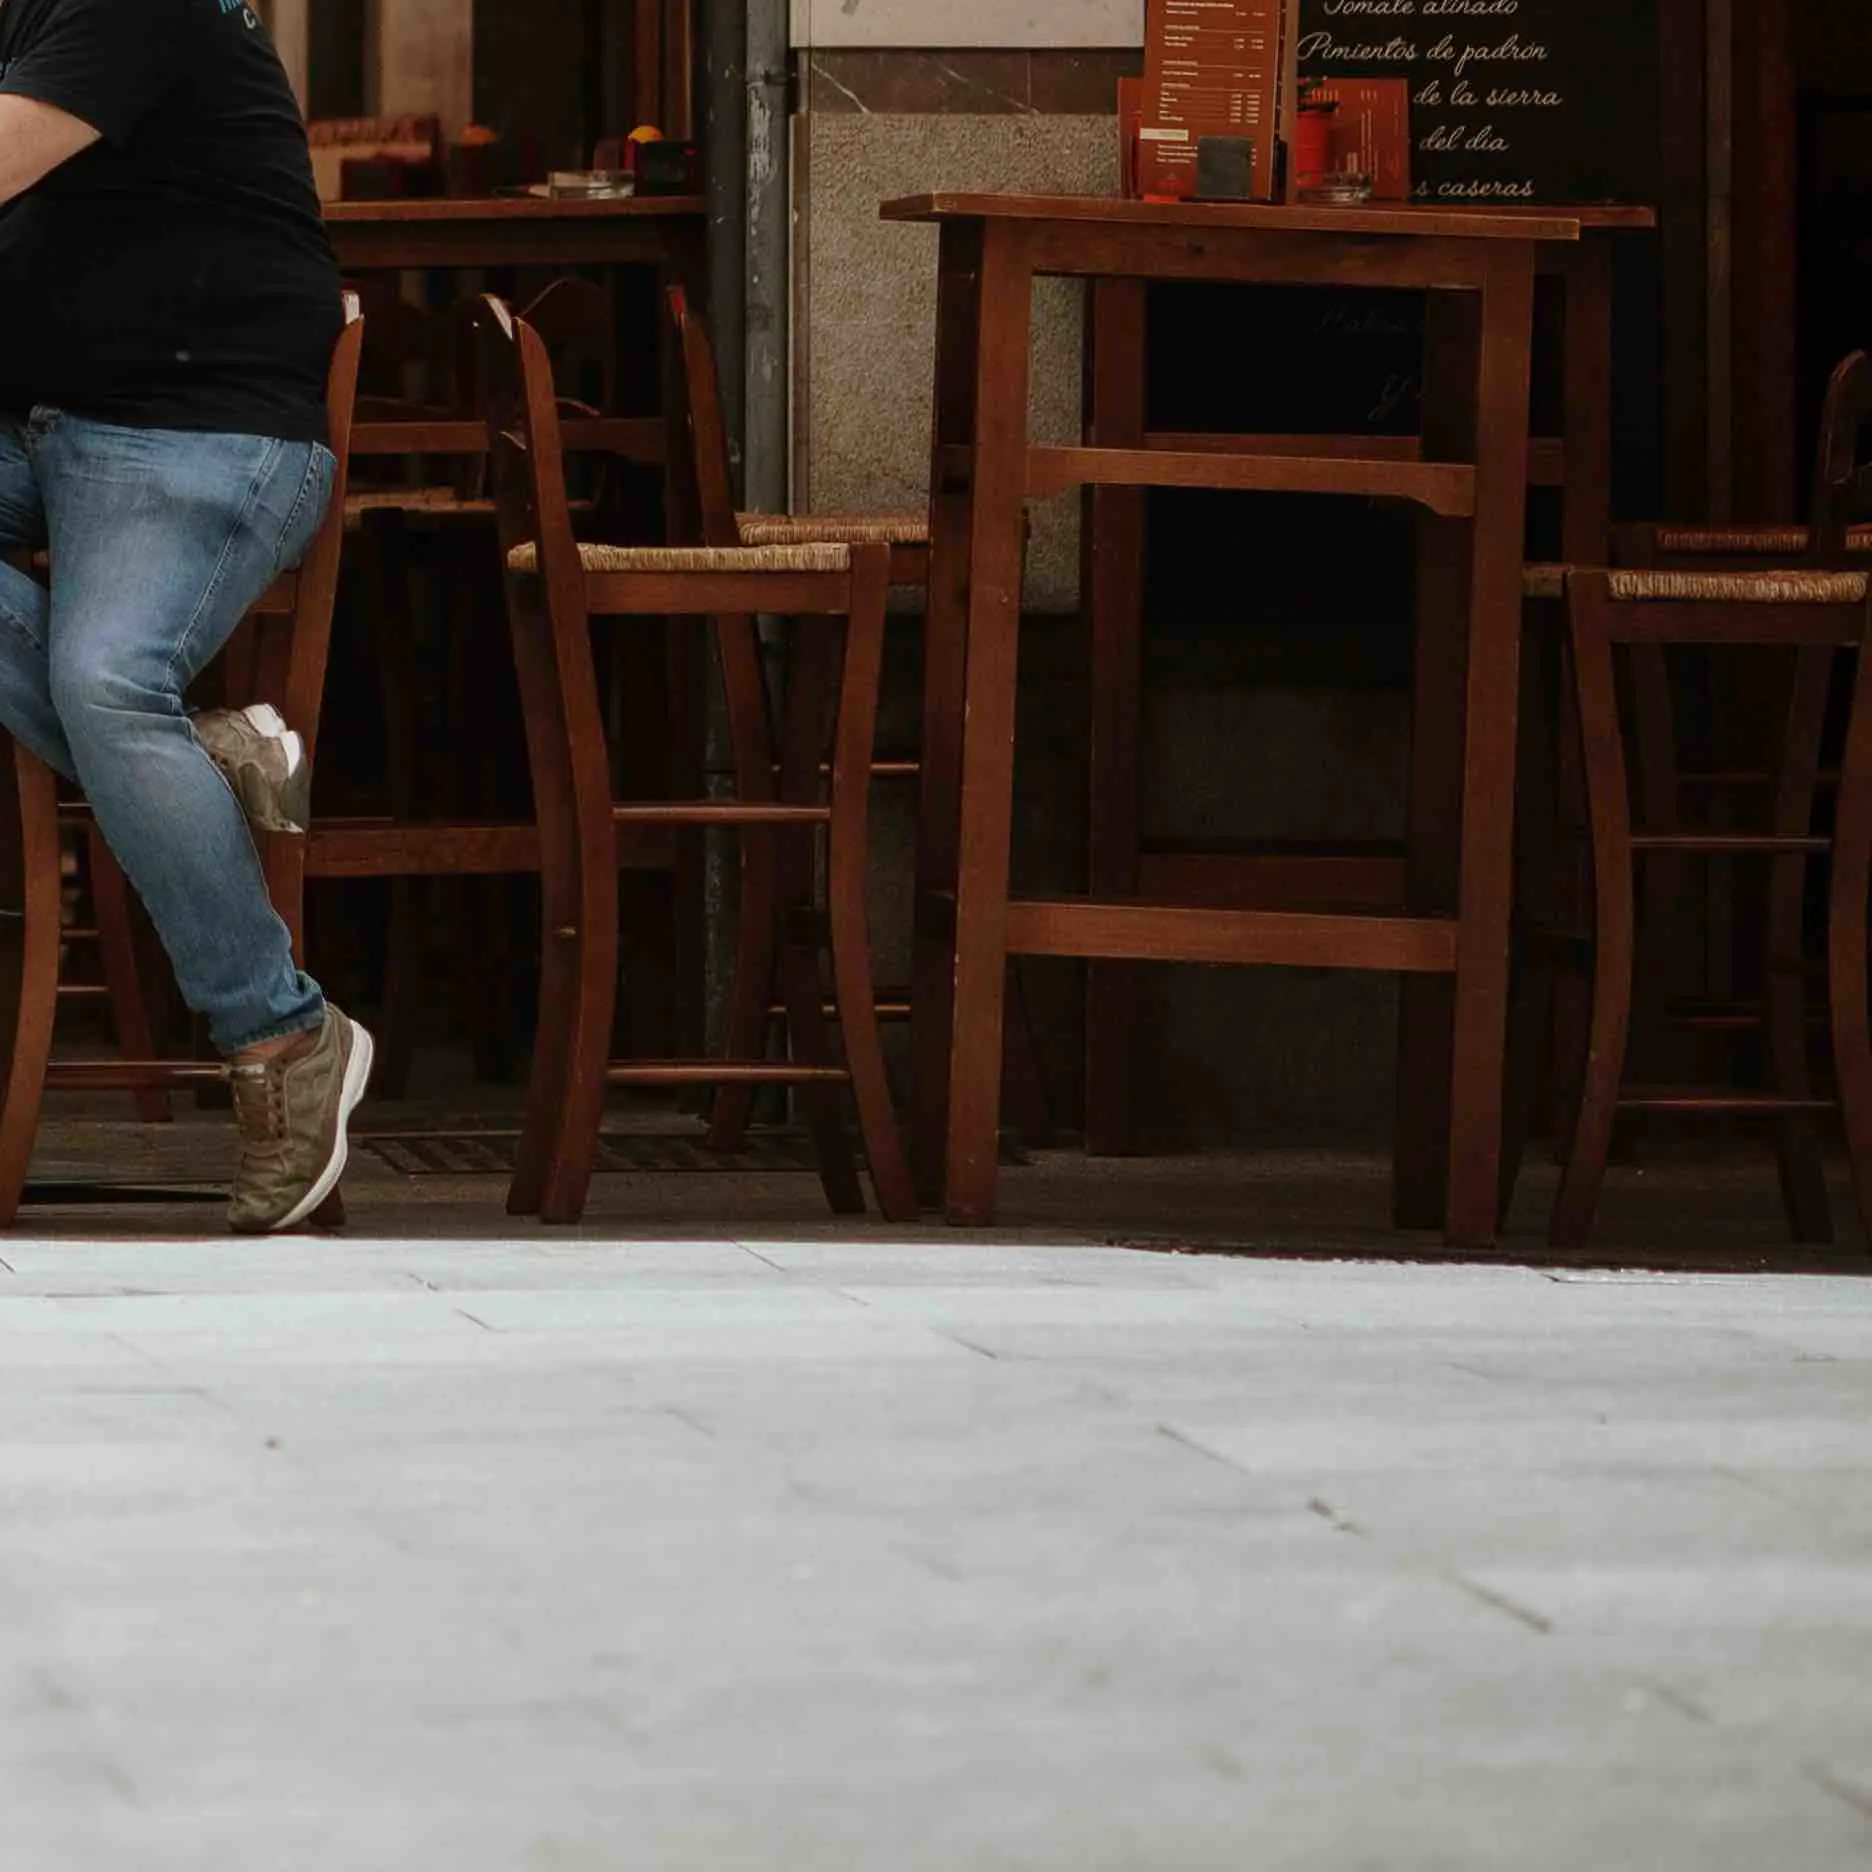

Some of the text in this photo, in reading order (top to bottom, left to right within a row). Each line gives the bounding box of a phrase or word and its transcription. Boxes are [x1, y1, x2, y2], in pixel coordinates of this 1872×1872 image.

[1296, 31, 1419, 62] Pimientos
[1426, 32, 1456, 60] de
[1454, 35, 1547, 76] padrón
[1413, 80, 1563, 107] de la sierra
[1419, 125, 1466, 151] del
[1438, 180, 1534, 197] caseras
